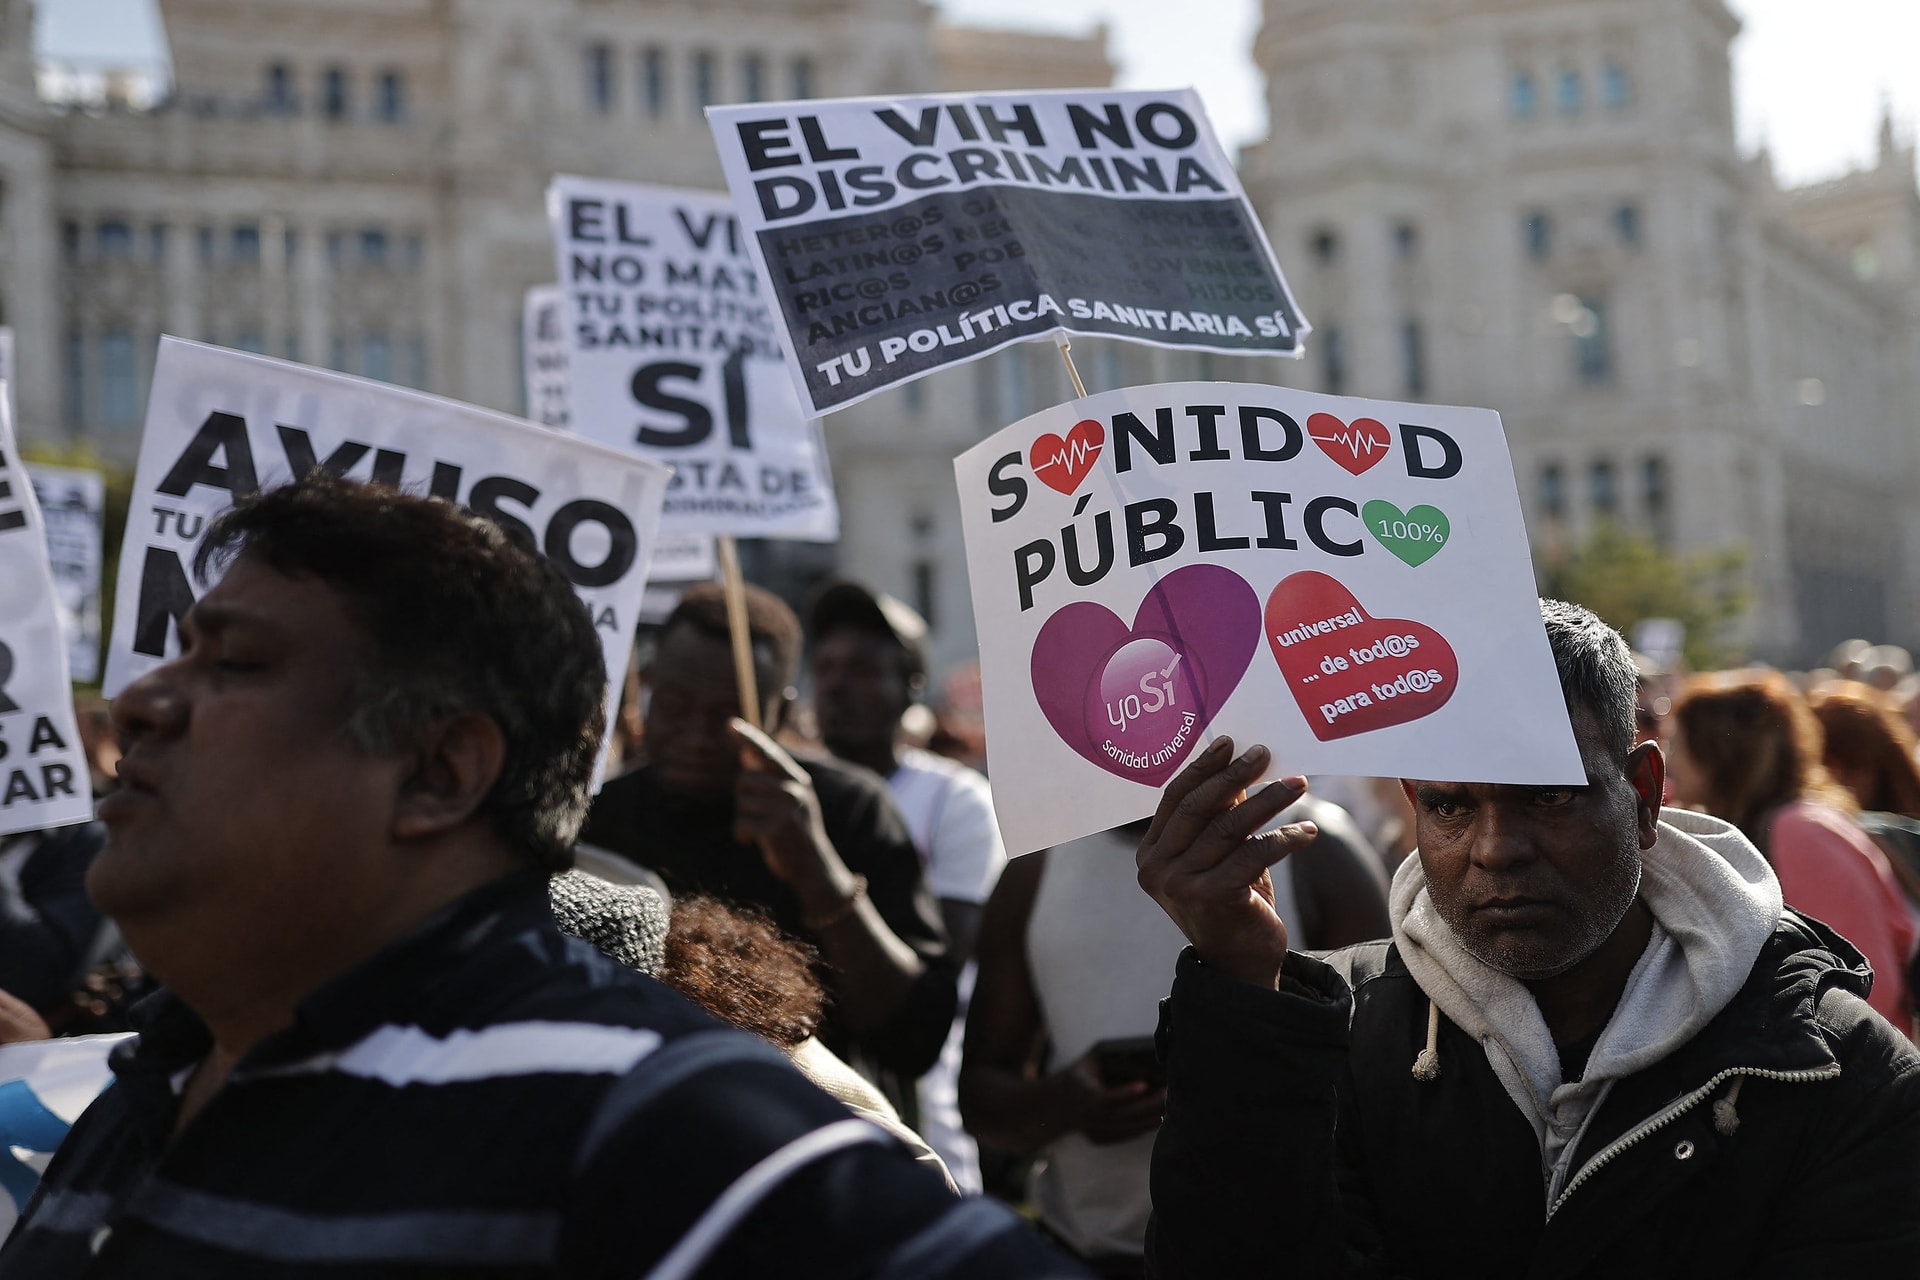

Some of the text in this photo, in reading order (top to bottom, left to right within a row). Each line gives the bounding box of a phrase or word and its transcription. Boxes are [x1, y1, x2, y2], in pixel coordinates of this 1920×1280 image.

[737, 102, 1198, 171] EL VIH NO
[753, 148, 1227, 222] DISCRIMINA
[570, 199, 738, 256] EL VI
[775, 206, 944, 258] HETER@S
[570, 252, 758, 297] NO MAT
[784, 234, 945, 285] LATIN@S
[576, 294, 621, 317] TU
[794, 272, 912, 315] RIC@S
[808, 272, 1003, 345] ANCIAN@S
[815, 293, 1291, 387] TU POLÍTICA SANITARIA SÍ
[631, 338, 752, 450] SÍ
[155, 411, 638, 588] AYUSO
[759, 464, 812, 498] DE
[152, 507, 203, 539] TU
[1378, 519, 1444, 543] 100%
[1276, 605, 1365, 648] universal
[1319, 655, 1350, 675] de
[1349, 633, 1421, 666] tod@s
[1319, 668, 1444, 724] para tod@s
[1102, 710, 1197, 769] sanidad universal
